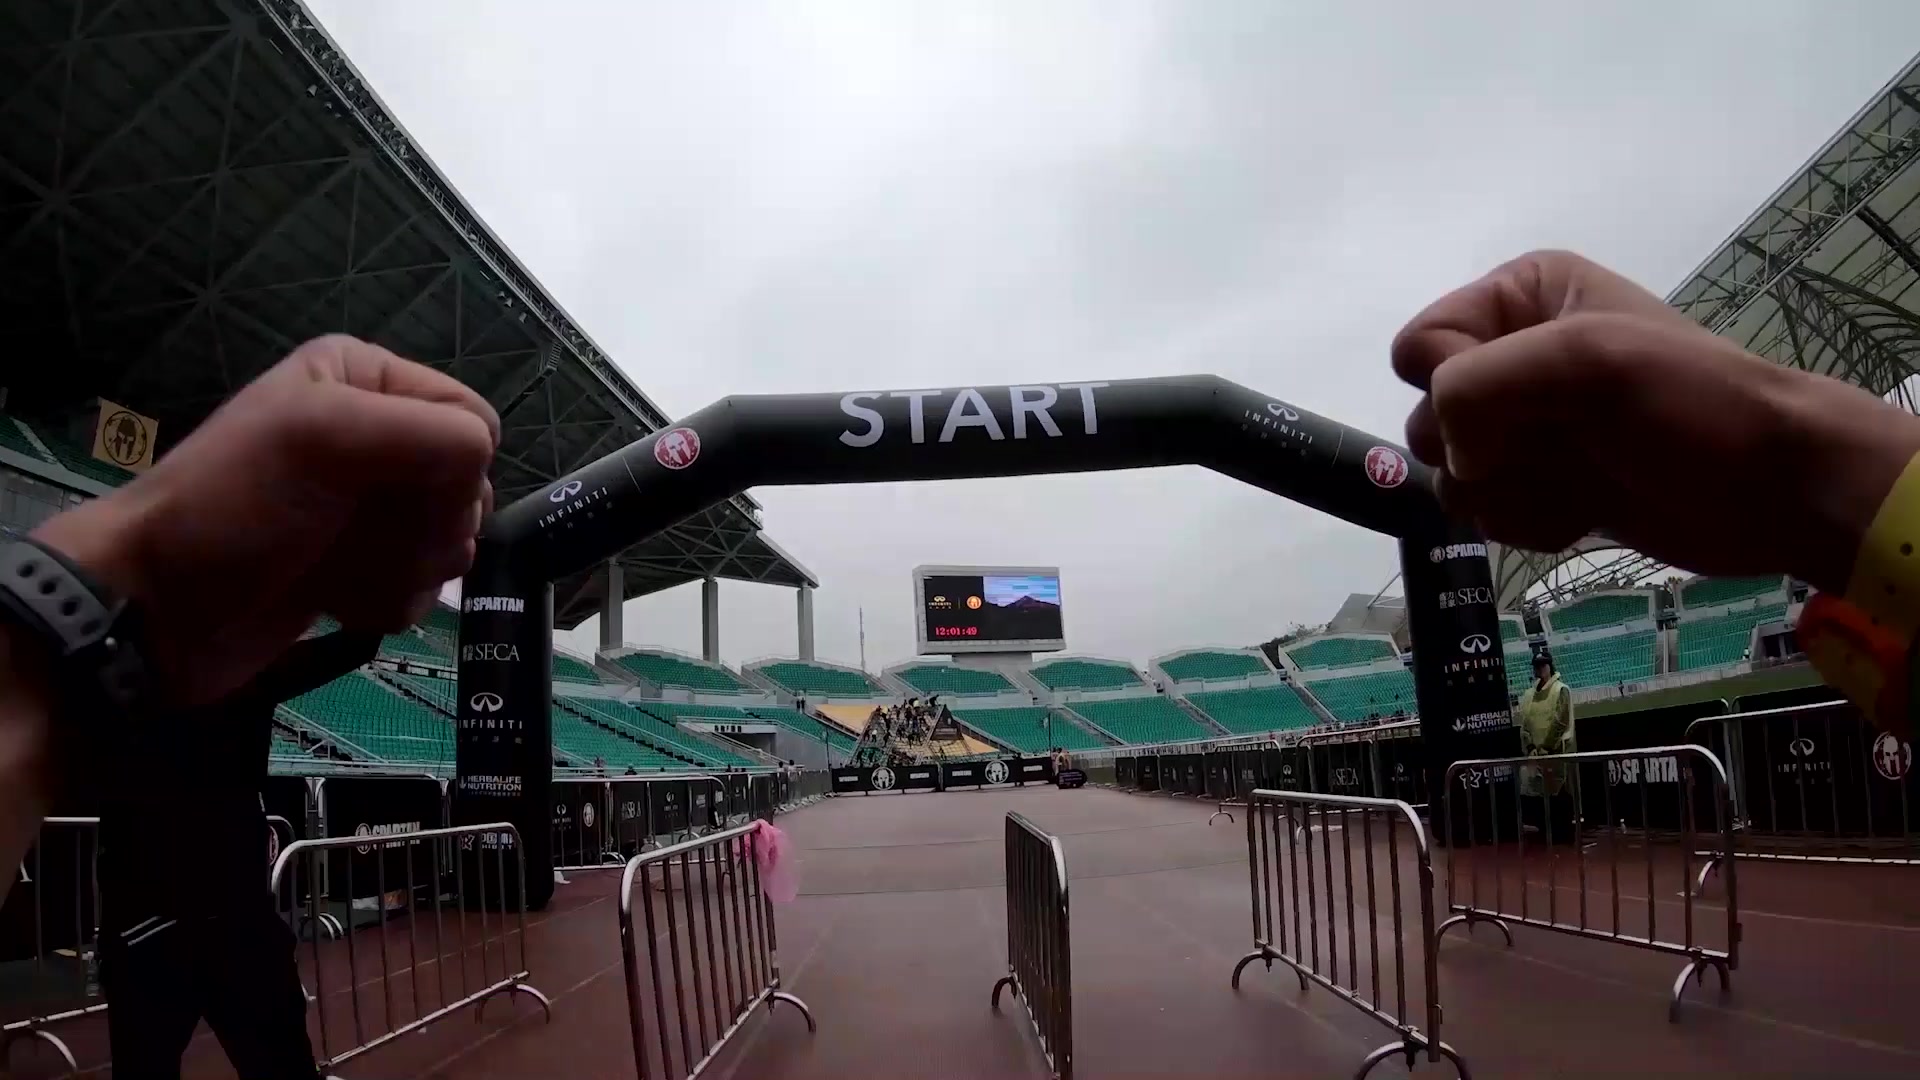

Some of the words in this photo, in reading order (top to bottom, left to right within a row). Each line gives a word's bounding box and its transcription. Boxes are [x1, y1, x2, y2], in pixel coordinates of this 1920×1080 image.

[838, 381, 1109, 448] START
[1244, 409, 1313, 444] INFINITI
[539, 486, 608, 528] INFINITI
[1457, 586, 1494, 606] SECA
[473, 597, 525, 613] SPARTAN
[935, 626, 978, 636] 12:01:49
[475, 643, 521, 662] SECA
[459, 719, 523, 730] INFINITI
[1467, 718, 1511, 730] NUTRITION
[1621, 755, 1690, 784] SPRTA
[1777, 761, 1831, 773] INFNITI
[467, 775, 522, 784] HERBALIFE
[467, 782, 522, 791] NUTRITION
